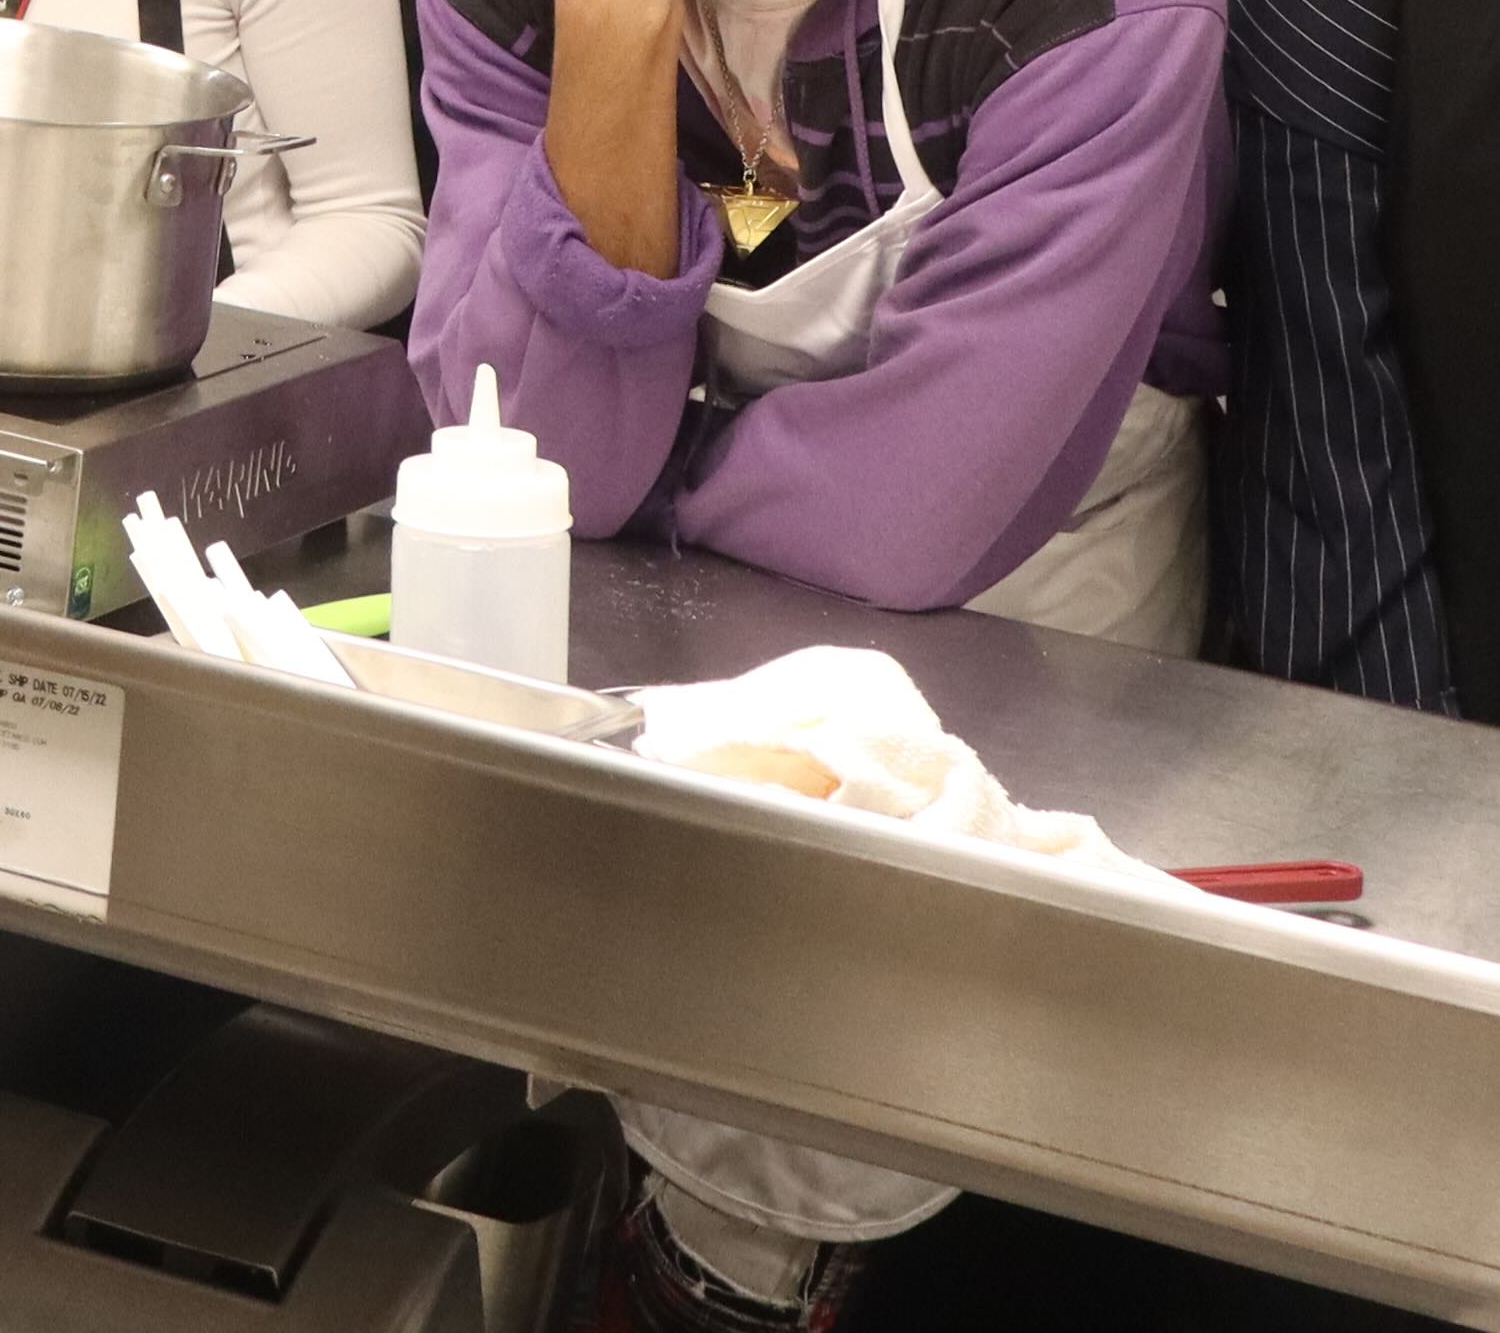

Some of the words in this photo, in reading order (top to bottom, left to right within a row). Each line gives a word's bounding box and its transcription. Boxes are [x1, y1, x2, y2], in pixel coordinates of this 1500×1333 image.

[8, 673, 29, 688] SHIP
[33, 678, 58, 695] DATE
[62, 684, 107, 707] 07/15/22
